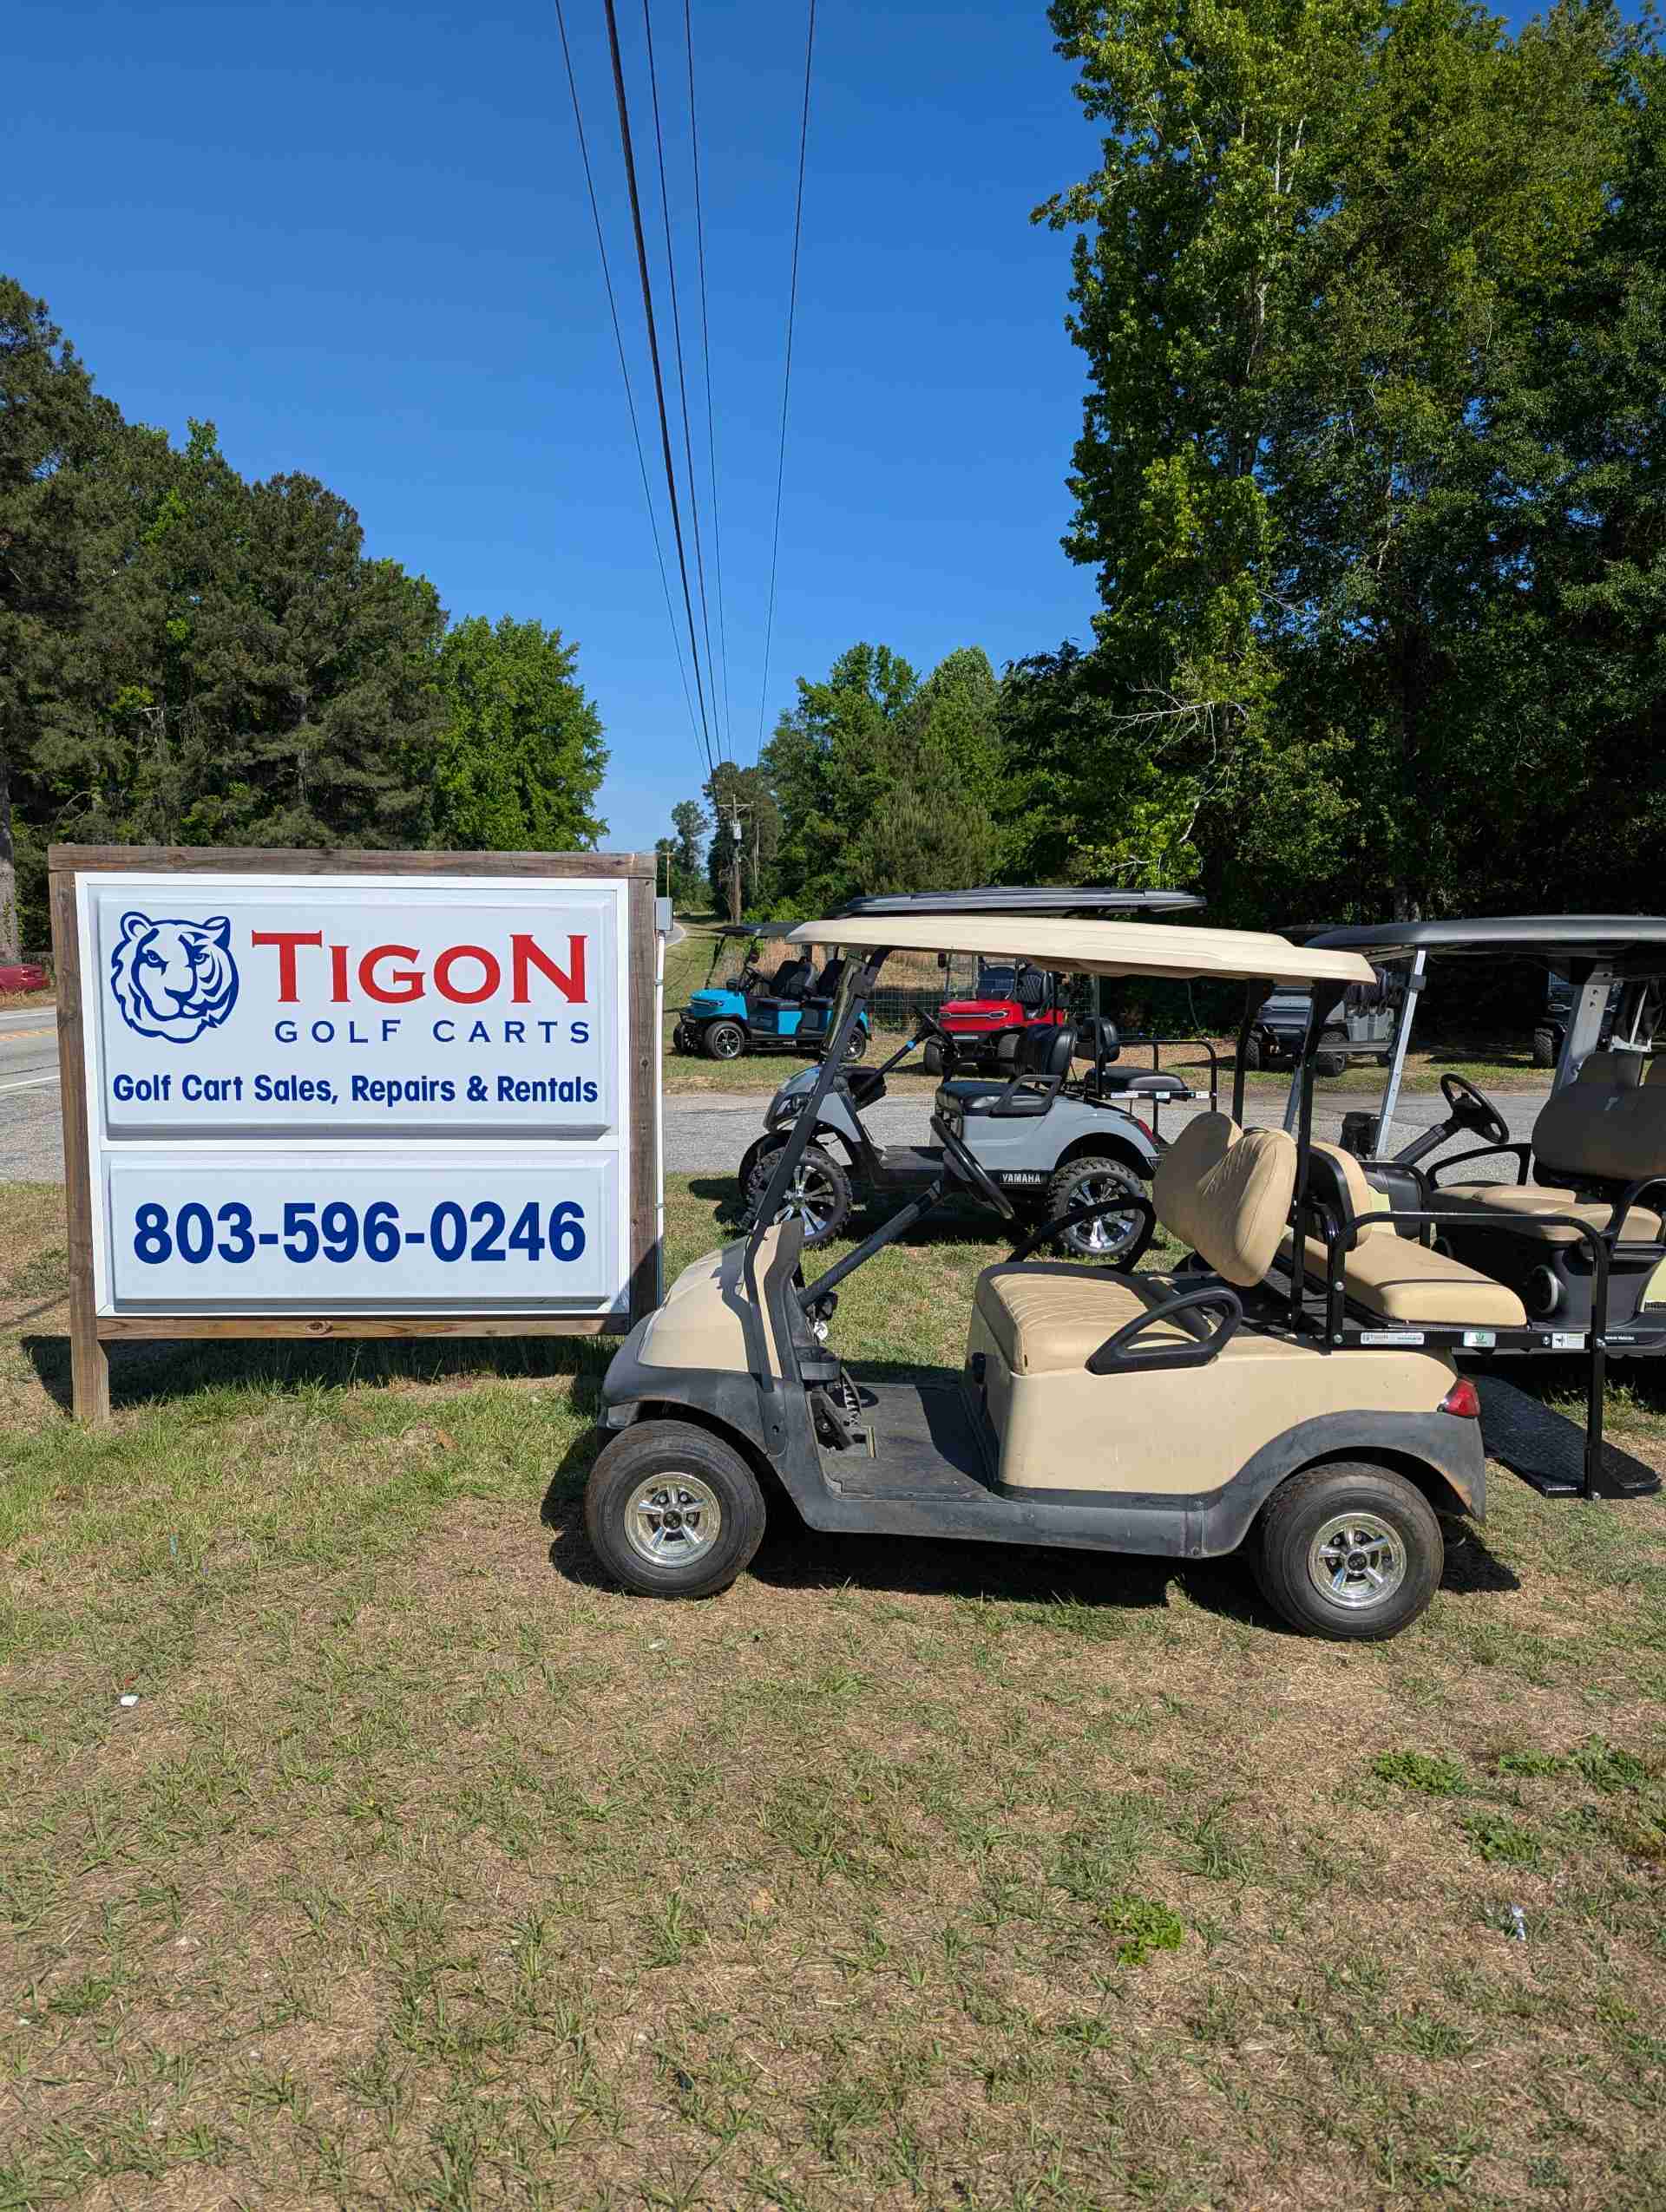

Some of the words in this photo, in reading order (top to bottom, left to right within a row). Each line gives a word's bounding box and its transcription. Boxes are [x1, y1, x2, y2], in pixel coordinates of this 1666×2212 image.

[252, 930, 588, 1004] TIGON
[274, 1019, 401, 1044] GOLF
[433, 1019, 589, 1044] CARTS
[113, 1074, 171, 1102] Golf
[181, 1074, 243, 1102] Cart
[253, 1074, 338, 1105] Sales,
[351, 1075, 456, 1108] Repairs
[466, 1075, 489, 1103] &
[497, 1075, 599, 1103] Rentals
[1002, 1173, 1041, 1183] YAMAHA
[133, 1201, 586, 1264] 803-596-0246
